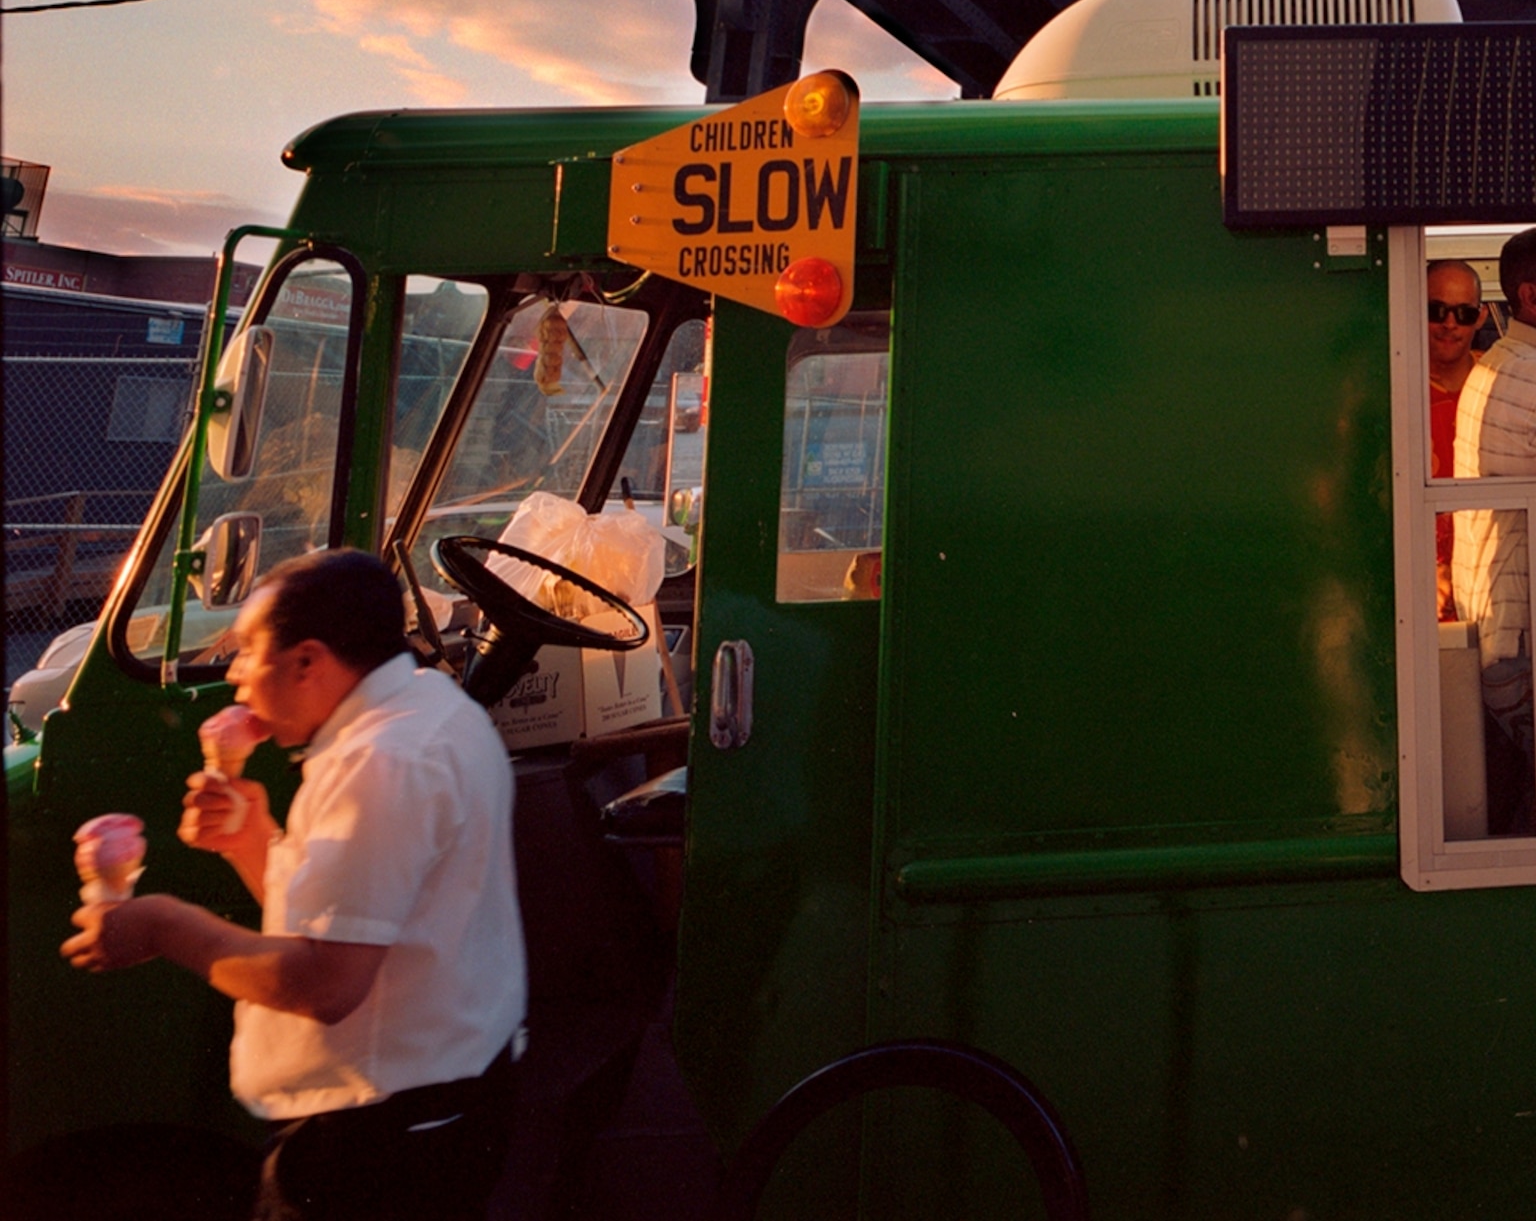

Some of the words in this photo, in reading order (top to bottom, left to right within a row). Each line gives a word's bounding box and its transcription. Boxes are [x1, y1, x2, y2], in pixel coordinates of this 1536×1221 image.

[690, 119, 793, 152] CHILDREN
[672, 156, 853, 236] SLOW
[679, 242, 790, 277] CROSSING
